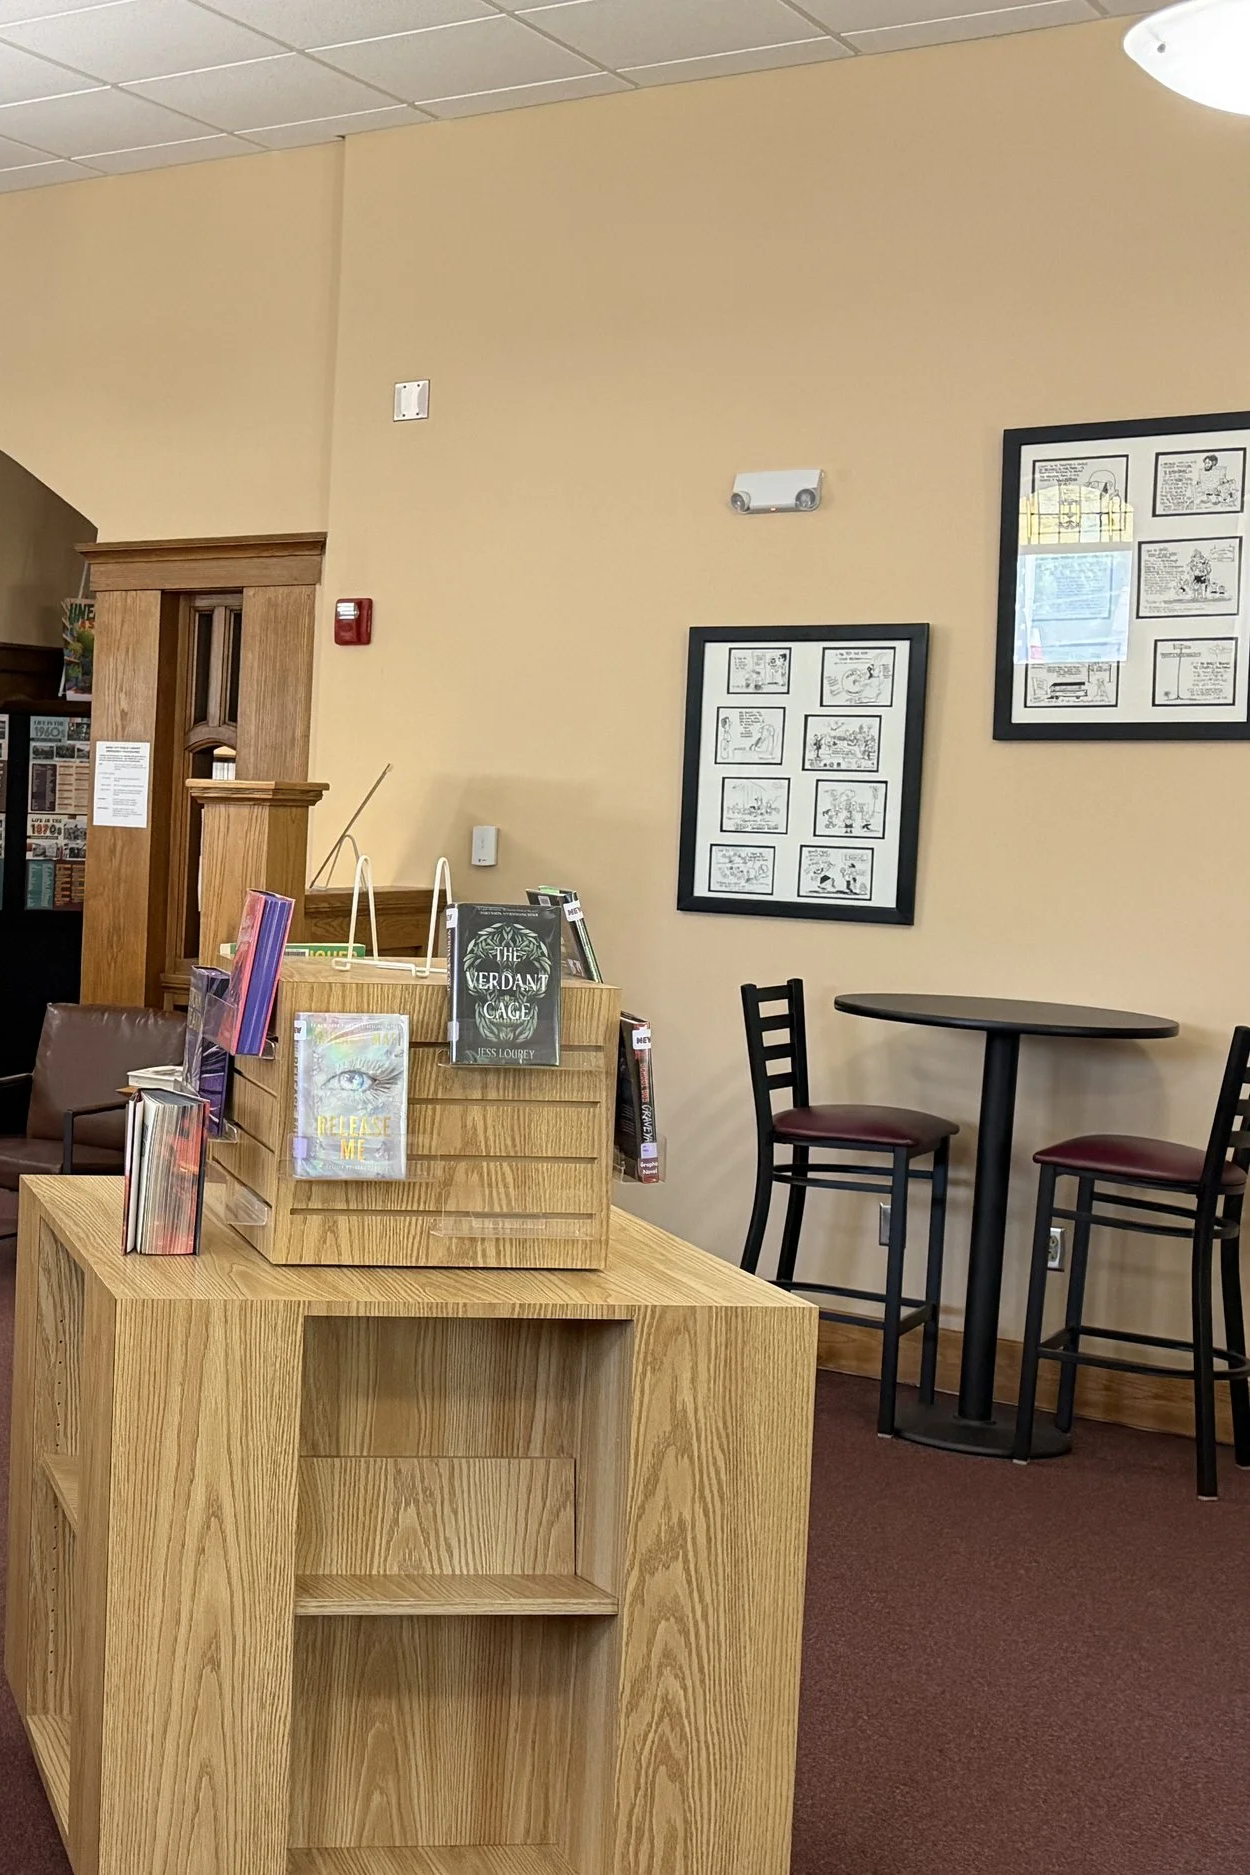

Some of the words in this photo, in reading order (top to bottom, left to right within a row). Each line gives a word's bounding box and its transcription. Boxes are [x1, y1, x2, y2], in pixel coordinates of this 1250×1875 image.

[34, 727, 65, 738] 1960s
[31, 824, 62, 835] 1970s
[494, 946, 522, 962] THE
[466, 972, 549, 992] VERDANT
[483, 1001, 531, 1020] CAGE
[477, 1047, 497, 1058] JESS
[499, 1047, 535, 1060] LOUREY
[317, 1116, 392, 1138] RELEASE
[340, 1138, 367, 1161] ME
